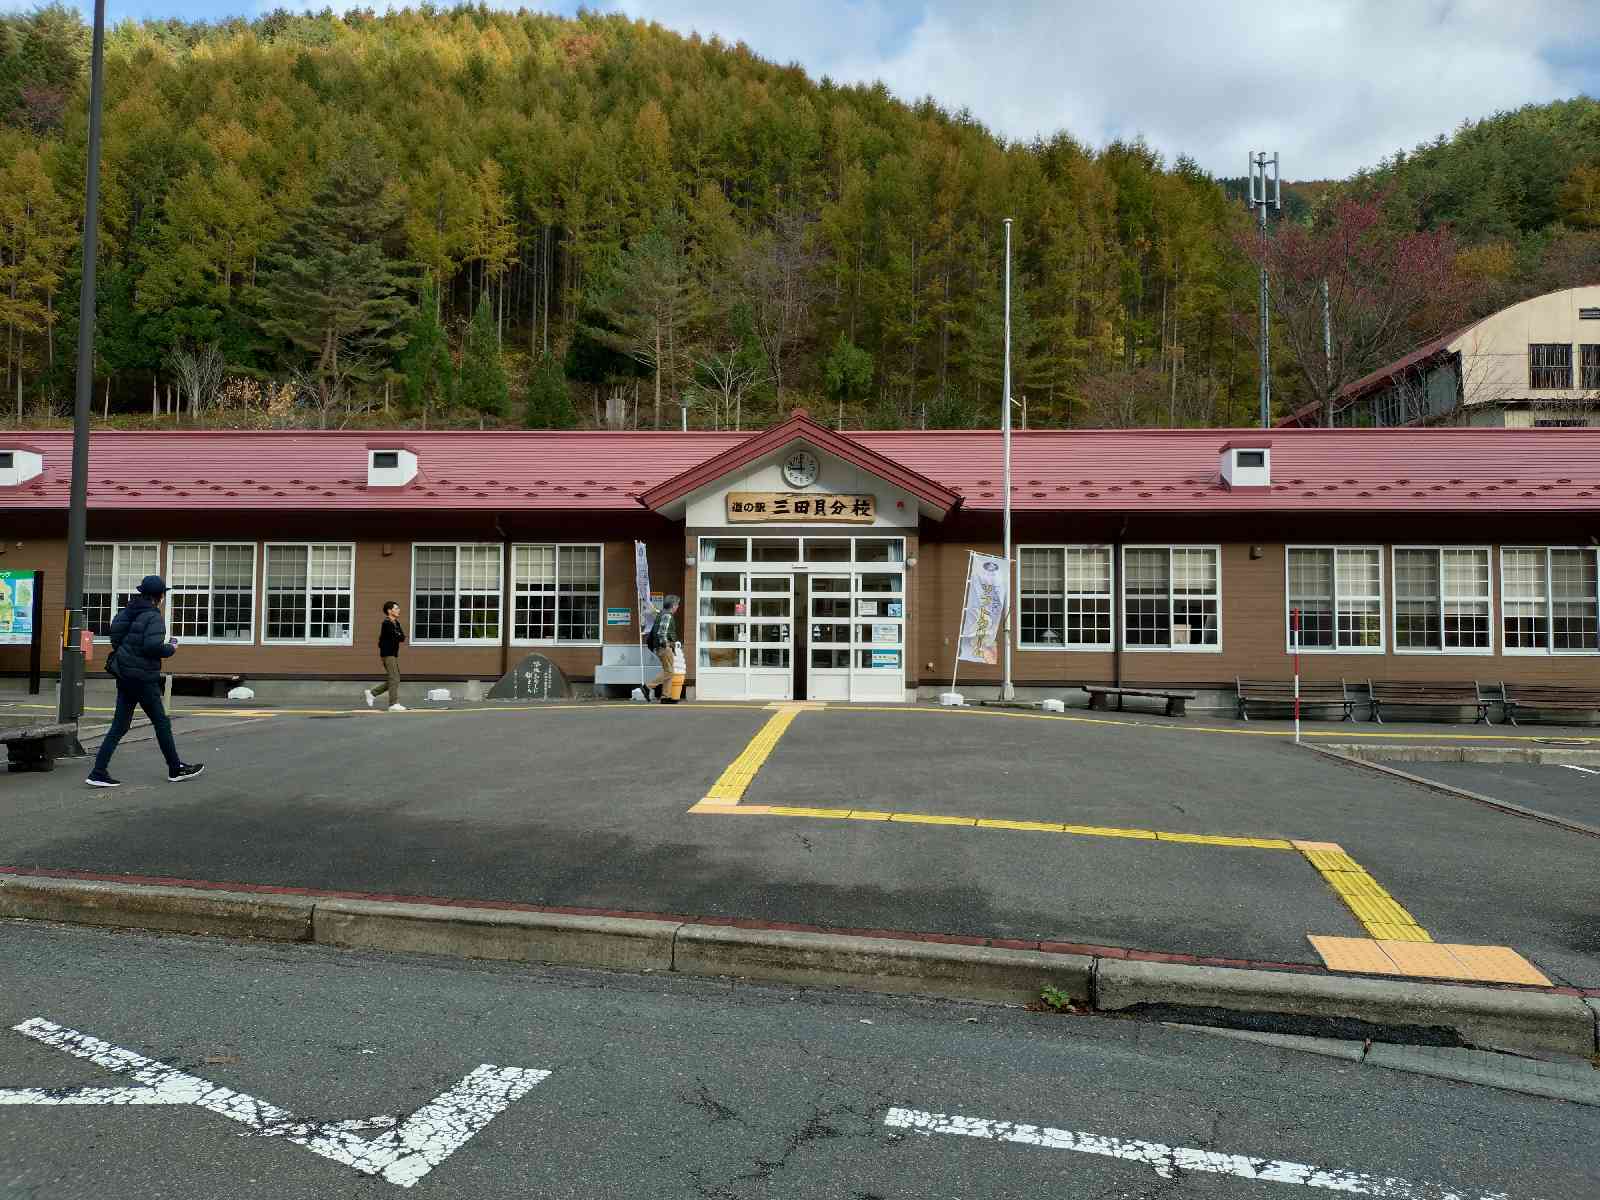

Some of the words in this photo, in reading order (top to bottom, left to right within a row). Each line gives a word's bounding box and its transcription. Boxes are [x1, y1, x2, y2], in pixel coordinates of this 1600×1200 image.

[772, 498, 873, 517] 三田貝分校
